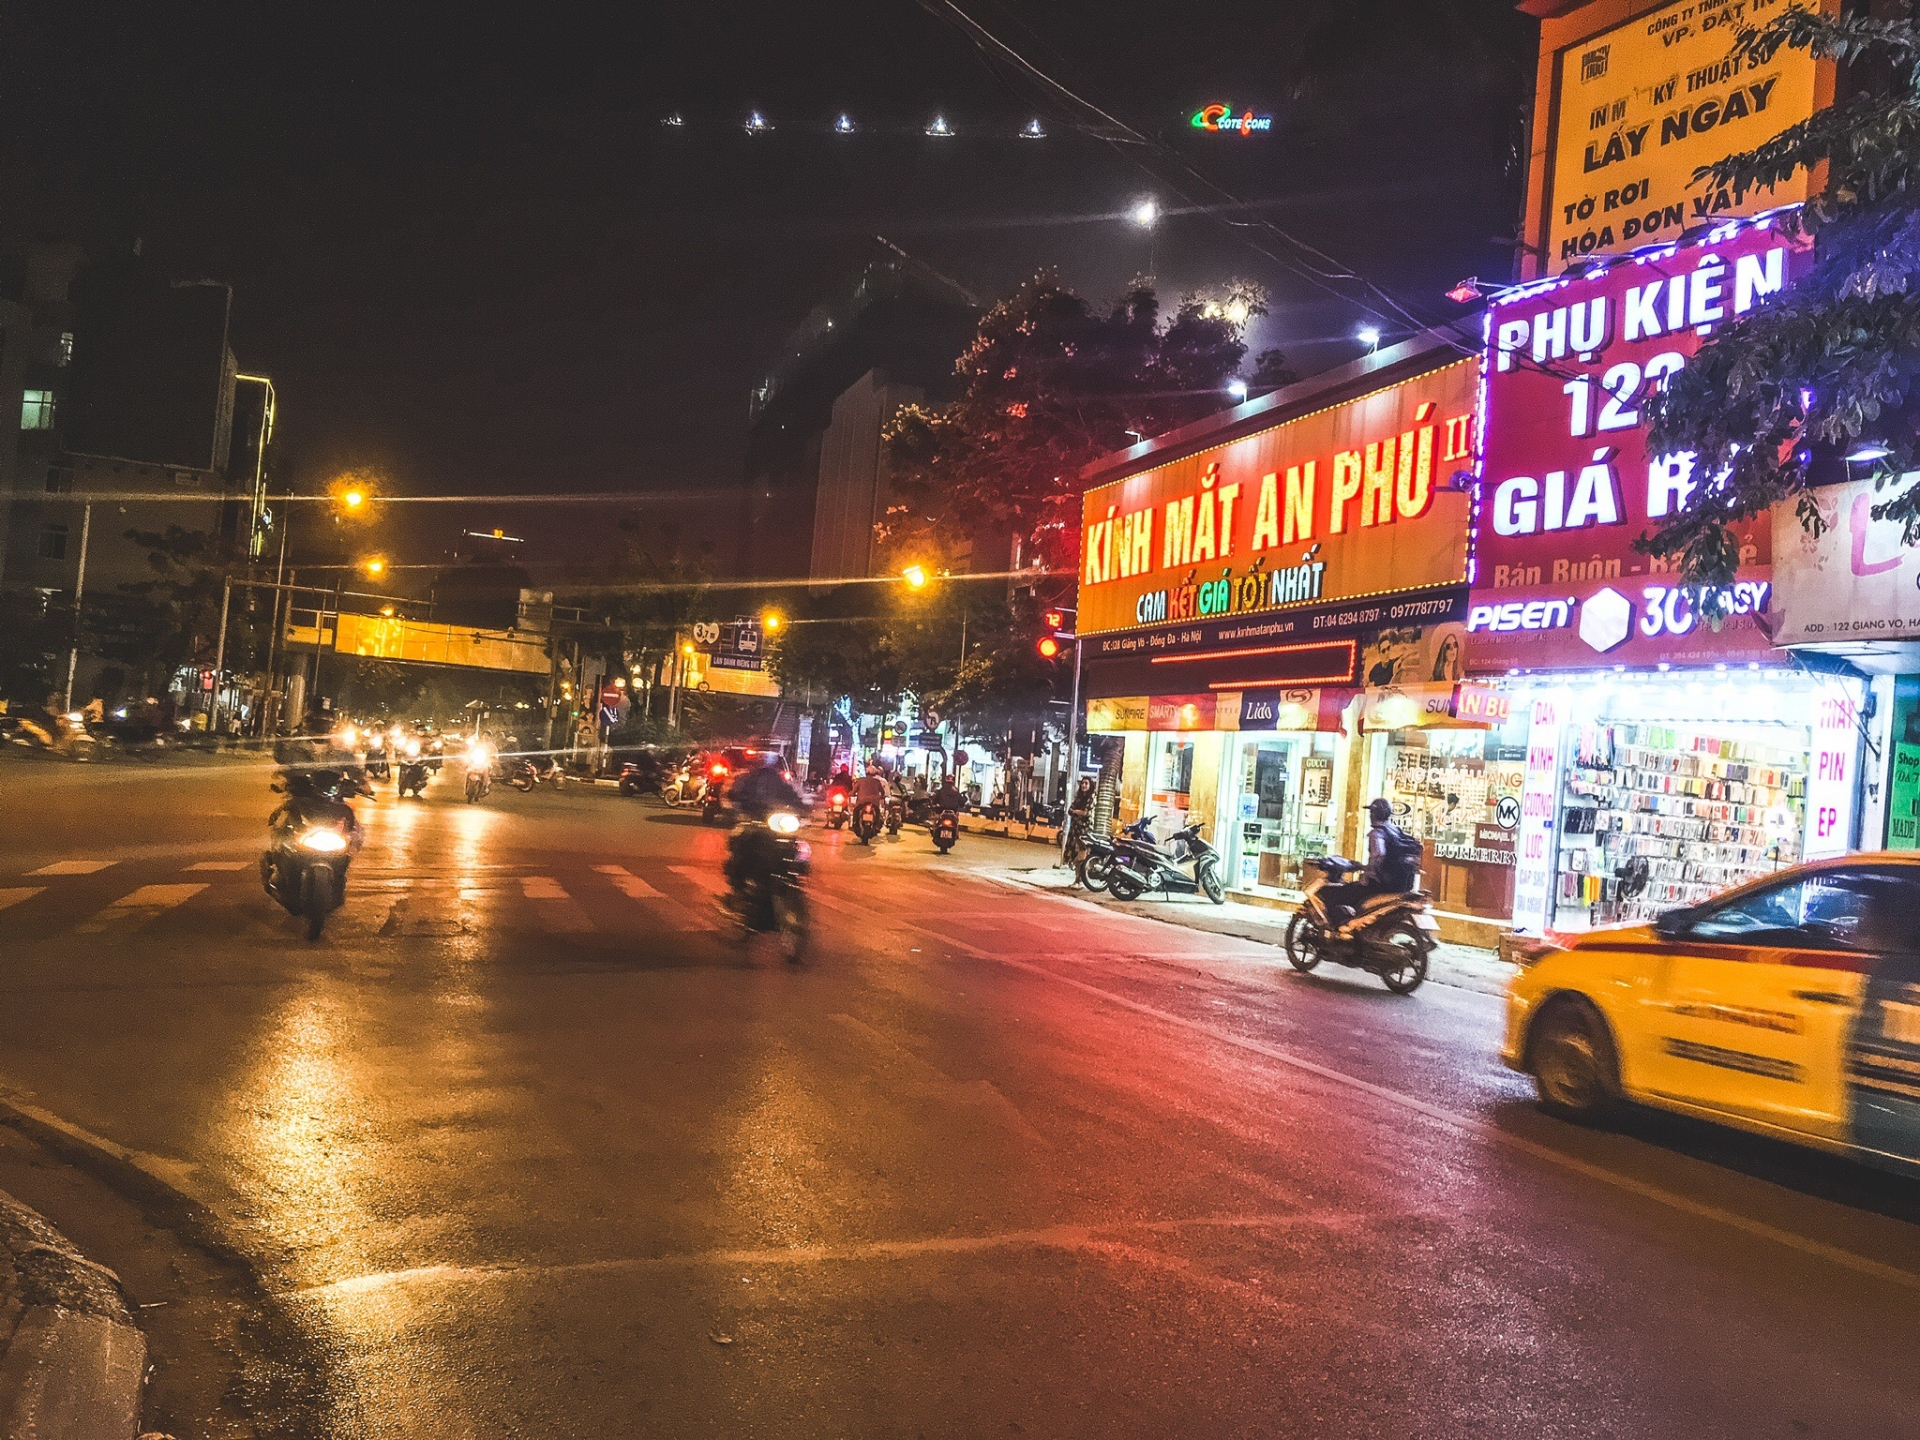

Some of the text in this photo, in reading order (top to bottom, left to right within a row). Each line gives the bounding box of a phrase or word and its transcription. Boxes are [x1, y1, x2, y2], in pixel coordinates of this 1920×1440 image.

[1647, 0, 1728, 36] CÔNG TY TNH
[1662, 26, 1695, 48] VP.
[1590, 106, 1608, 130] IN
[1686, 54, 1742, 94] THUẬT
[1583, 77, 1777, 174] LẤY NGAY
[1564, 178, 1650, 225] TỜ RƠI
[1561, 226, 1615, 260] HÓA
[1622, 202, 1684, 240] ĐƠN
[1498, 247, 1788, 372] PHỤ KIỆN
[1084, 402, 1473, 586] KÍNH MẮT AN PHÚ II
[1492, 447, 1618, 537] GIÁ
[1136, 543, 1326, 624] CAM KẾT GIÁ TỐT NHẤT
[1494, 561, 1542, 589] Bán
[1552, 553, 1621, 583] Buôn
[1045, 613, 1061, 627] 72
[1338, 612, 1358, 626] 6294
[1359, 607, 1380, 623] 8797
[1390, 597, 1454, 620] 0977787797
[1467, 599, 1570, 633] PISEN
[1640, 586, 1693, 636] 3C
[1803, 623, 1825, 633] ADD
[1833, 622, 1850, 631] 122
[1852, 619, 1886, 631] GIANG
[1888, 618, 1906, 630] VO,
[1115, 708, 1146, 720] SUNFIRE
[1246, 701, 1273, 720] Lido
[1305, 758, 1328, 768] GUCCI
[1818, 751, 1846, 782] PIN
[1898, 752, 1920, 769] Shop
[1499, 804, 1518, 821] MK
[1892, 818, 1916, 839] MADE
